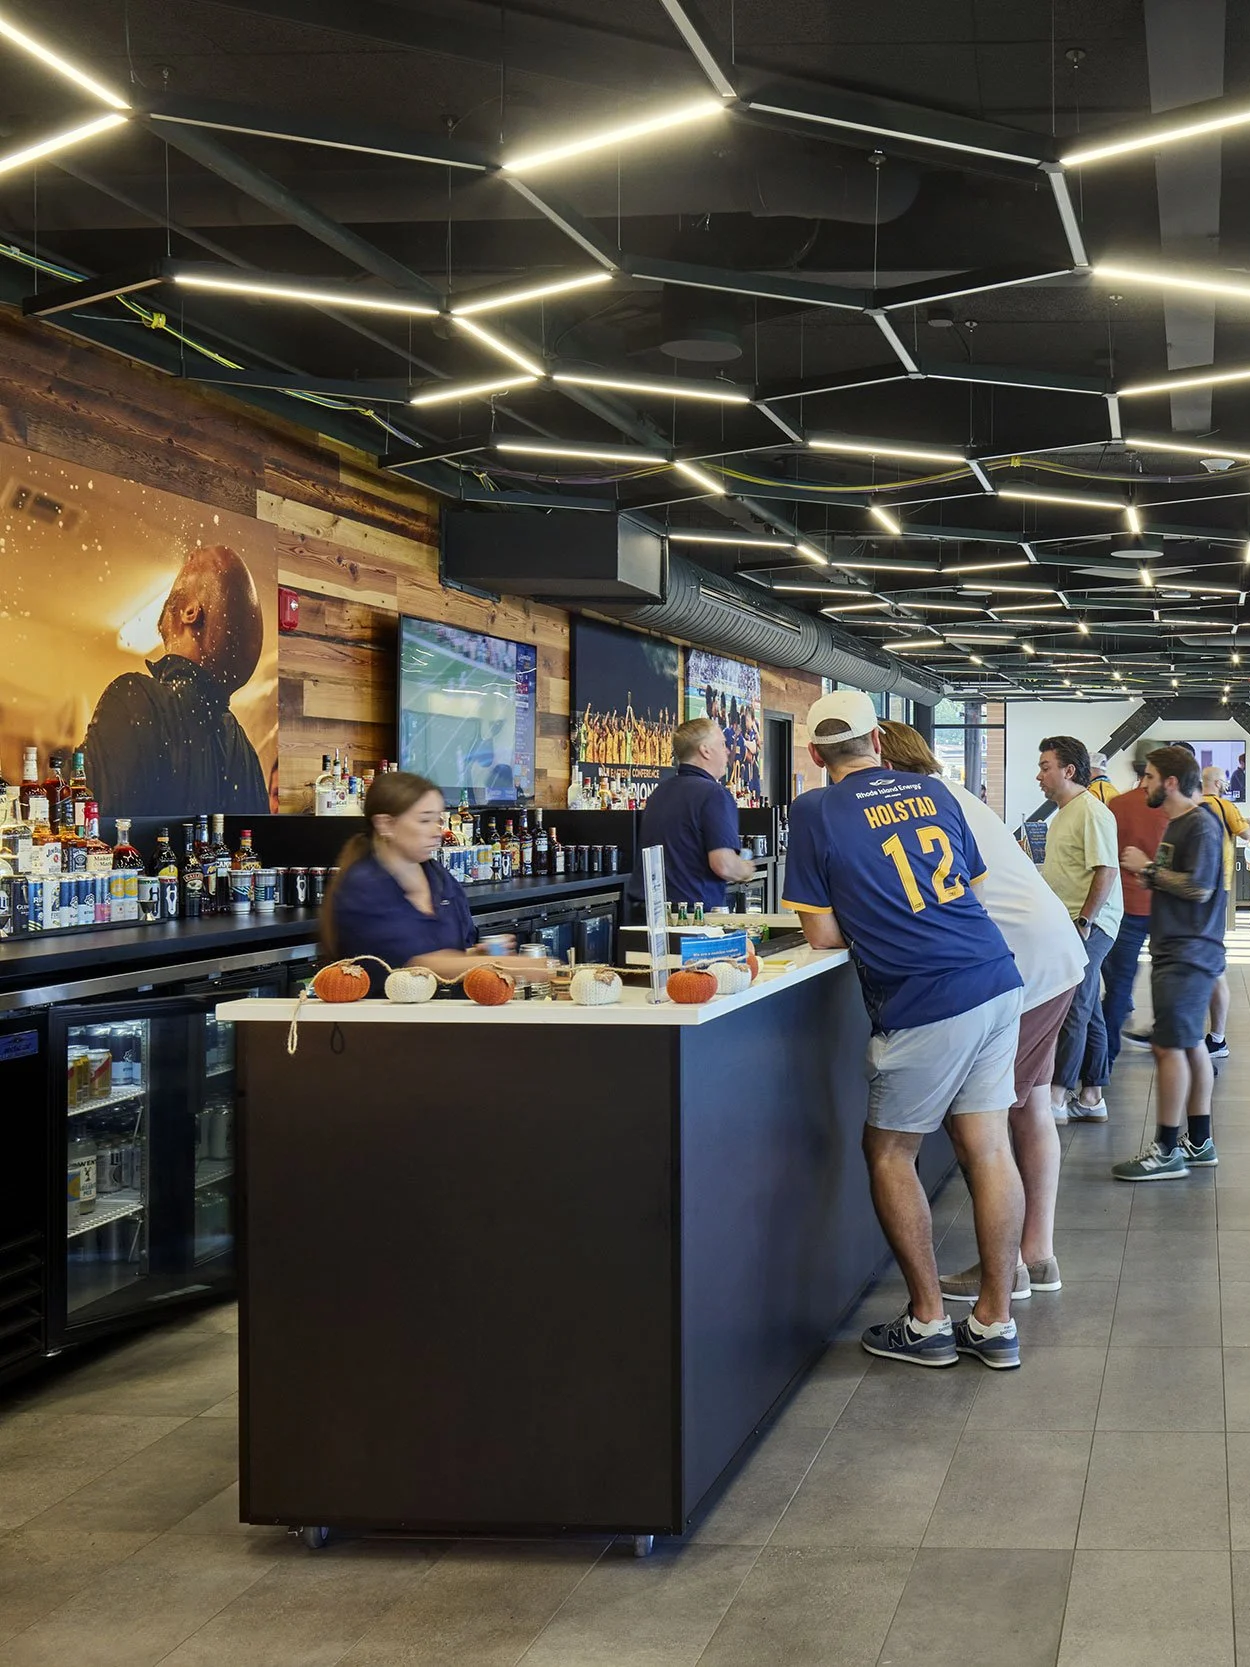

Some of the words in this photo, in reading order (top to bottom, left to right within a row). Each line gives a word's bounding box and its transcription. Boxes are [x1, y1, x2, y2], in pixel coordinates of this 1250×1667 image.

[855, 790, 878, 800] Rhode
[878, 785, 899, 795] Island
[863, 796, 938, 830] HOLSTAD
[881, 825, 966, 914] 12
